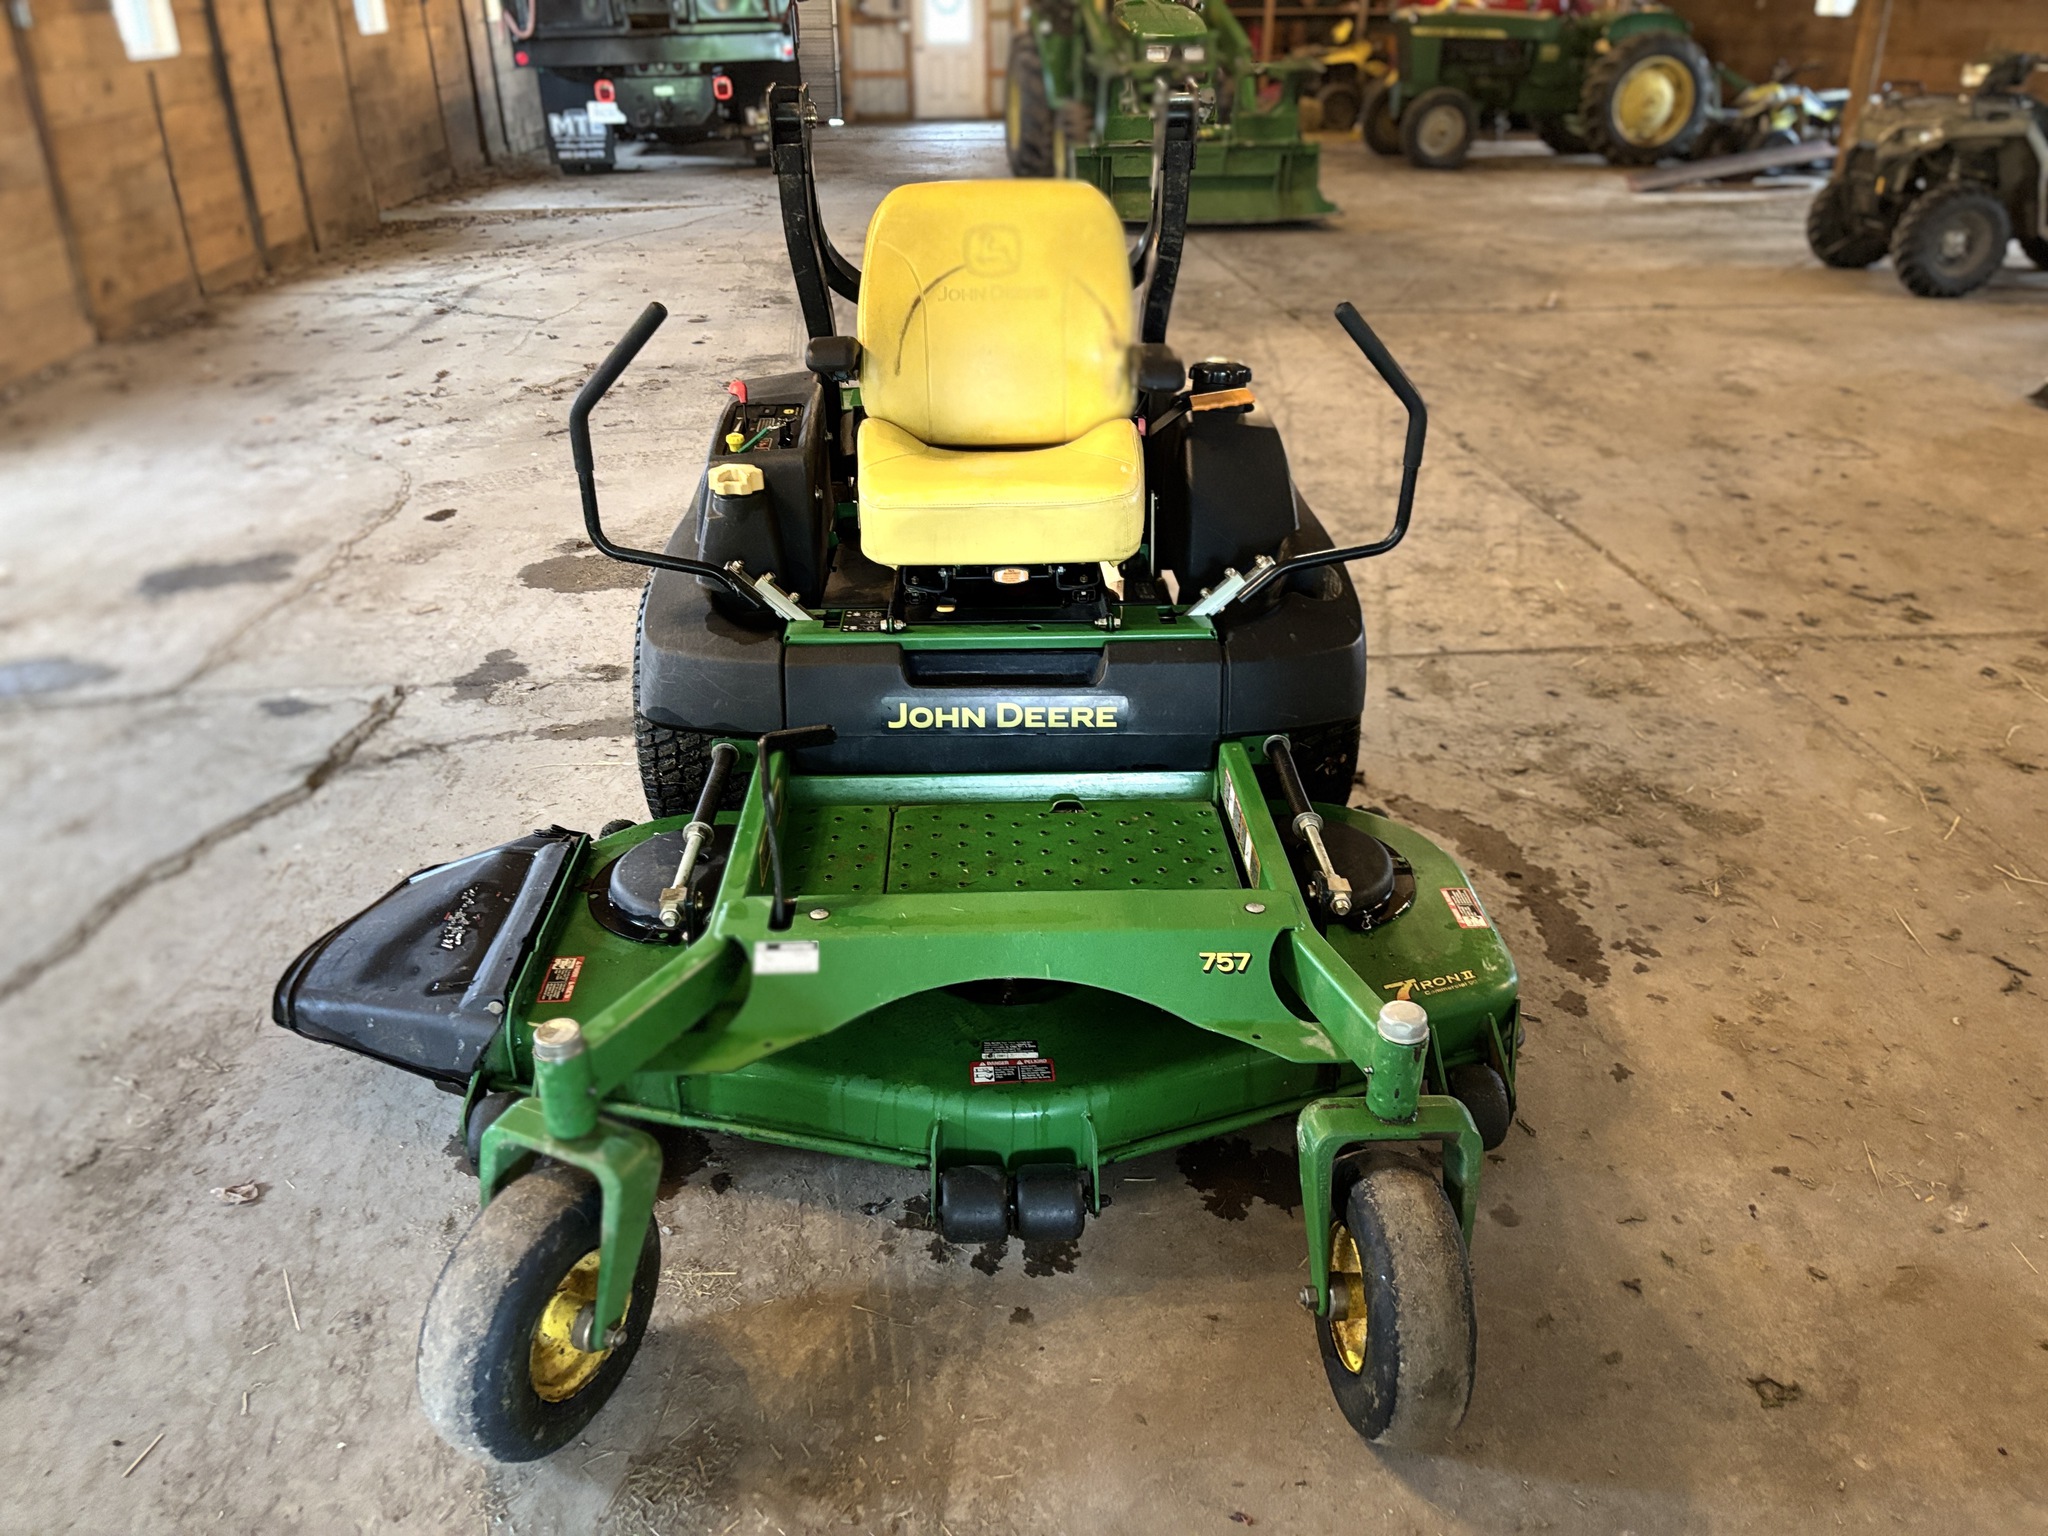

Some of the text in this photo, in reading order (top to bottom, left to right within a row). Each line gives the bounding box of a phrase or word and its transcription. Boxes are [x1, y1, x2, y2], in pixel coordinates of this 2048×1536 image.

[938, 286, 986, 302] JOHN
[888, 702, 1118, 729] JOHN DEERE
[1199, 952, 1252, 973] 757
